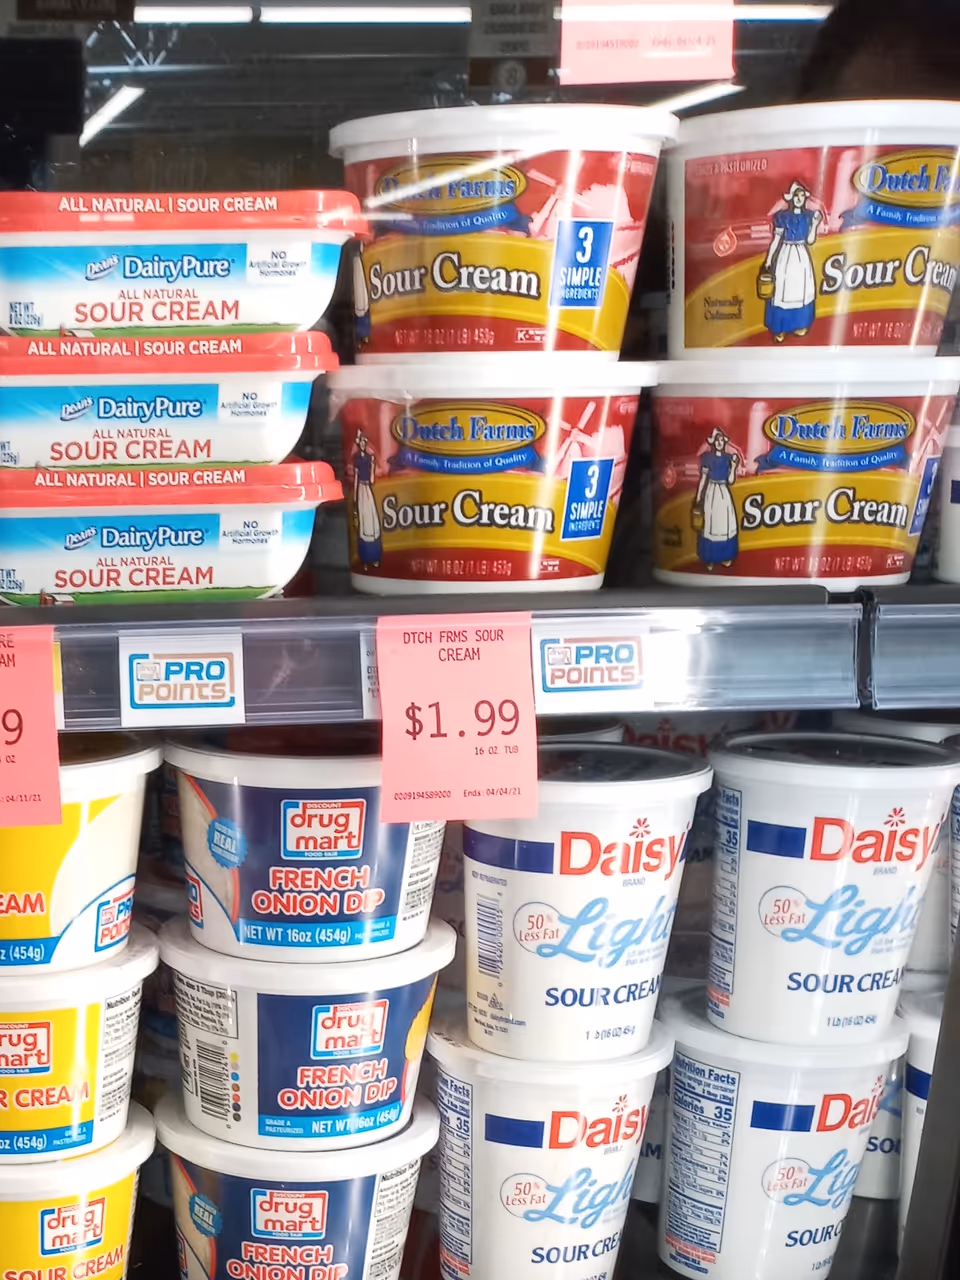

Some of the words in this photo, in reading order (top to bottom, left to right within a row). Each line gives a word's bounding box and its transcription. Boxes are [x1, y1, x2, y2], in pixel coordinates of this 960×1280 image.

[59, 197, 88, 213] ALL
[92, 197, 165, 213] NATURAL
[177, 197, 221, 212] SOUR
[225, 196, 277, 211] CREAM
[576, 226, 594, 264] 3
[369, 262, 427, 300] Sour
[431, 252, 540, 300] Cream
[559, 267, 602, 287] SIMPLE
[74, 302, 143, 323] SOUR
[152, 300, 240, 321] CREAM
[401, 415, 464, 442] Dutch
[470, 415, 536, 442] Farms
[776, 415, 846, 440] Dutch
[851, 415, 909, 441] Farms
[585, 465, 600, 499] 3
[382, 496, 447, 530] Sour
[452, 490, 556, 532] Cream
[570, 501, 605, 519] SIMPLE
[742, 494, 821, 529] Sour
[826, 488, 908, 529] Cream
[403, 631, 432, 644] DTCH
[440, 630, 468, 643] FRMS
[475, 629, 504, 642] SOUR
[438, 647, 481, 662] CREAM
[405, 698, 520, 741] $1.99
[474, 746, 485, 756] 16
[488, 746, 499, 755] OZ
[504, 745, 519, 755] TUB
[290, 811, 350, 833] drug
[295, 831, 359, 850] mart
[559, 818, 682, 881] Daisy
[809, 807, 937, 872] Daisy
[271, 867, 368, 888] FRENCH
[253, 892, 338, 914] ONION
[345, 890, 383, 914] DIP
[519, 928, 540, 942] Less
[542, 928, 560, 943] Fat
[787, 971, 856, 994] SOUR
[544, 987, 612, 1008] SOUR
[707, 1068, 737, 1087] Facts
[714, 1105, 732, 1122] 35
[242, 1243, 333, 1264] FRENCH
